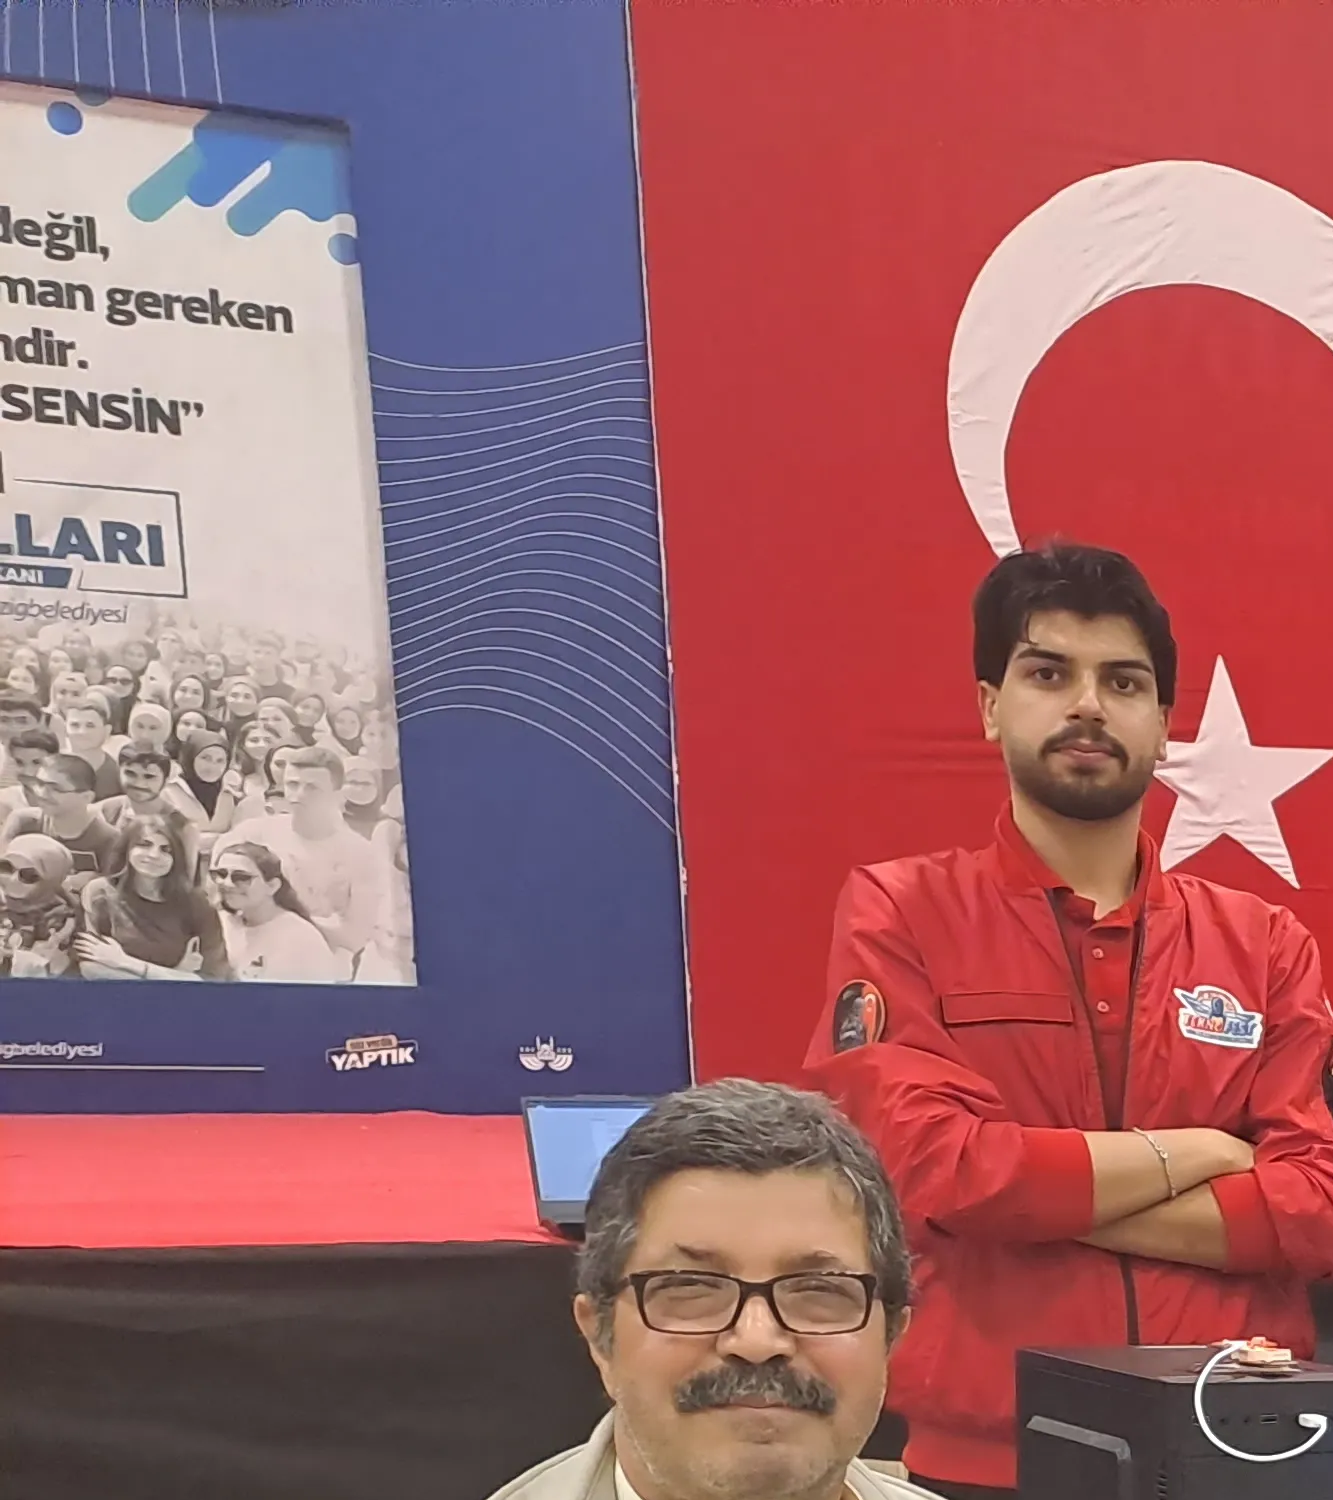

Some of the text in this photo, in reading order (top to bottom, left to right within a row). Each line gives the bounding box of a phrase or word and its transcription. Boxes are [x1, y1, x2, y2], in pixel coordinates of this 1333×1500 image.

[106, 288, 293, 333] gereken
[0, 513, 166, 567] LARI
[331, 1046, 415, 1071] YAPTIK
